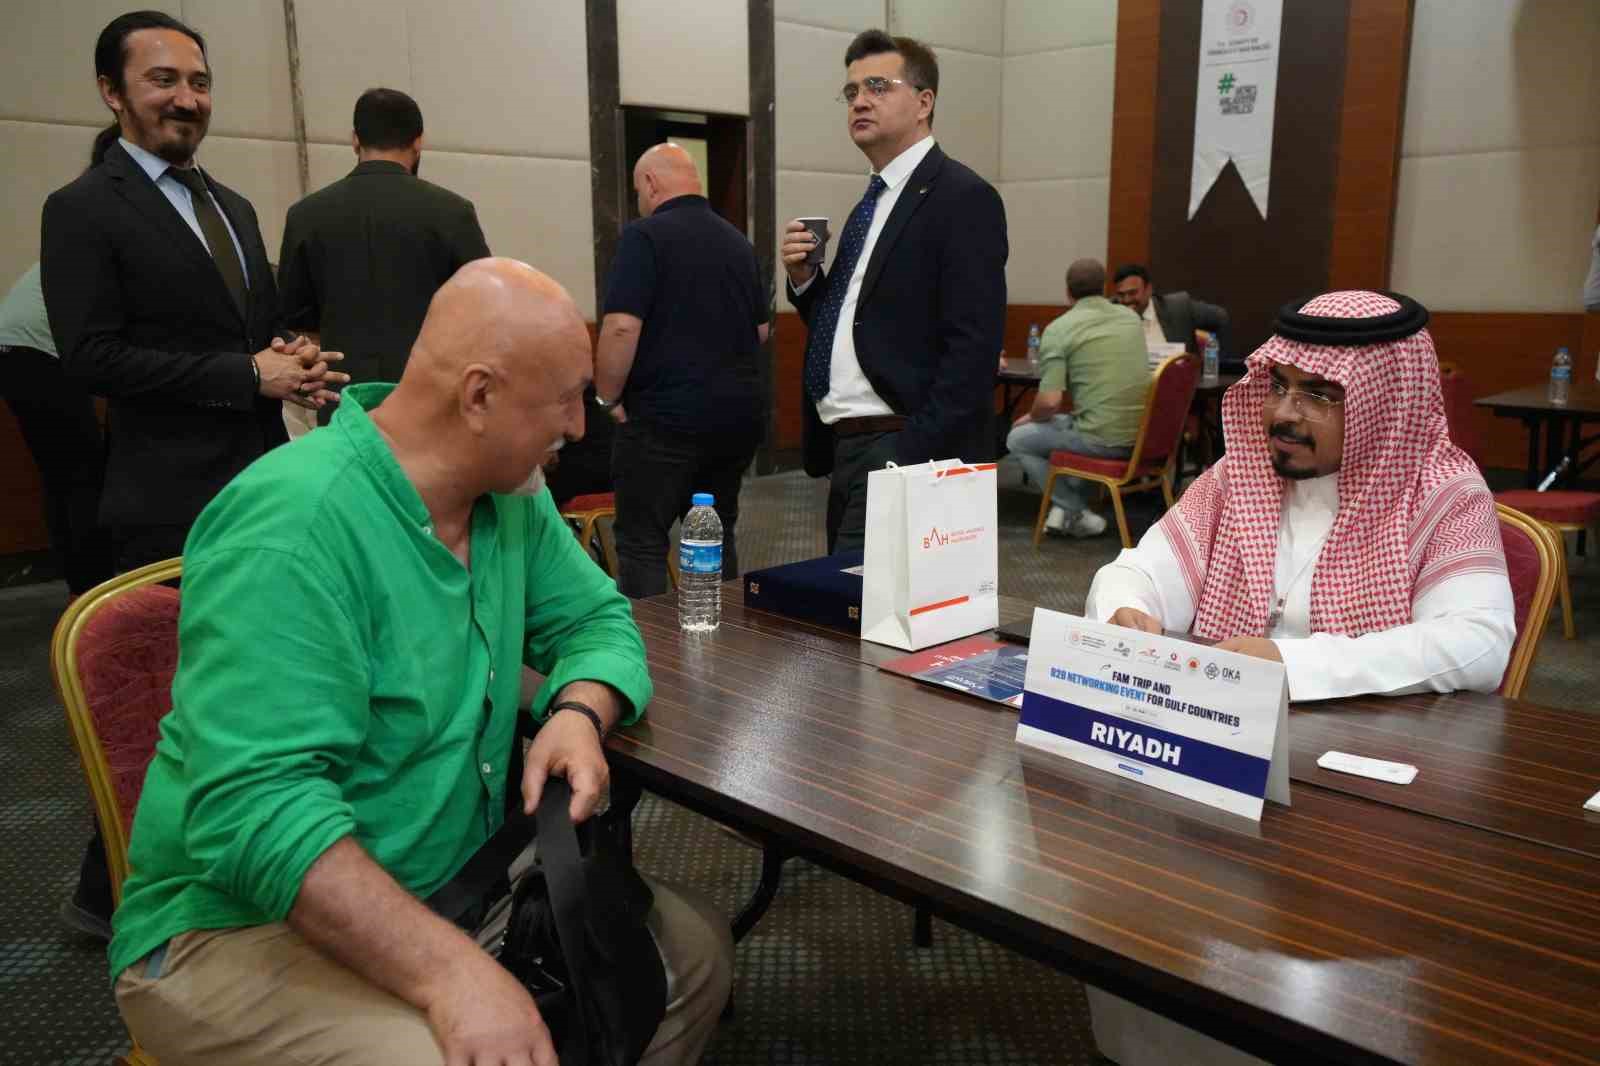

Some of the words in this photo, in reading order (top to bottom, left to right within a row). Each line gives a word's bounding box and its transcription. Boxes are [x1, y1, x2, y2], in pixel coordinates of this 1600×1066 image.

[1067, 671, 1119, 695] NETWORKING
[1120, 686, 1146, 701] EVENT
[1146, 693, 1163, 707] FOR
[1164, 698, 1187, 713] GULF
[1187, 704, 1240, 727] COUNTRIES
[1112, 671, 1130, 684] FAM
[1132, 676, 1153, 690] TRIP
[1152, 682, 1171, 695] AND
[1090, 721, 1181, 766] RIYADH
